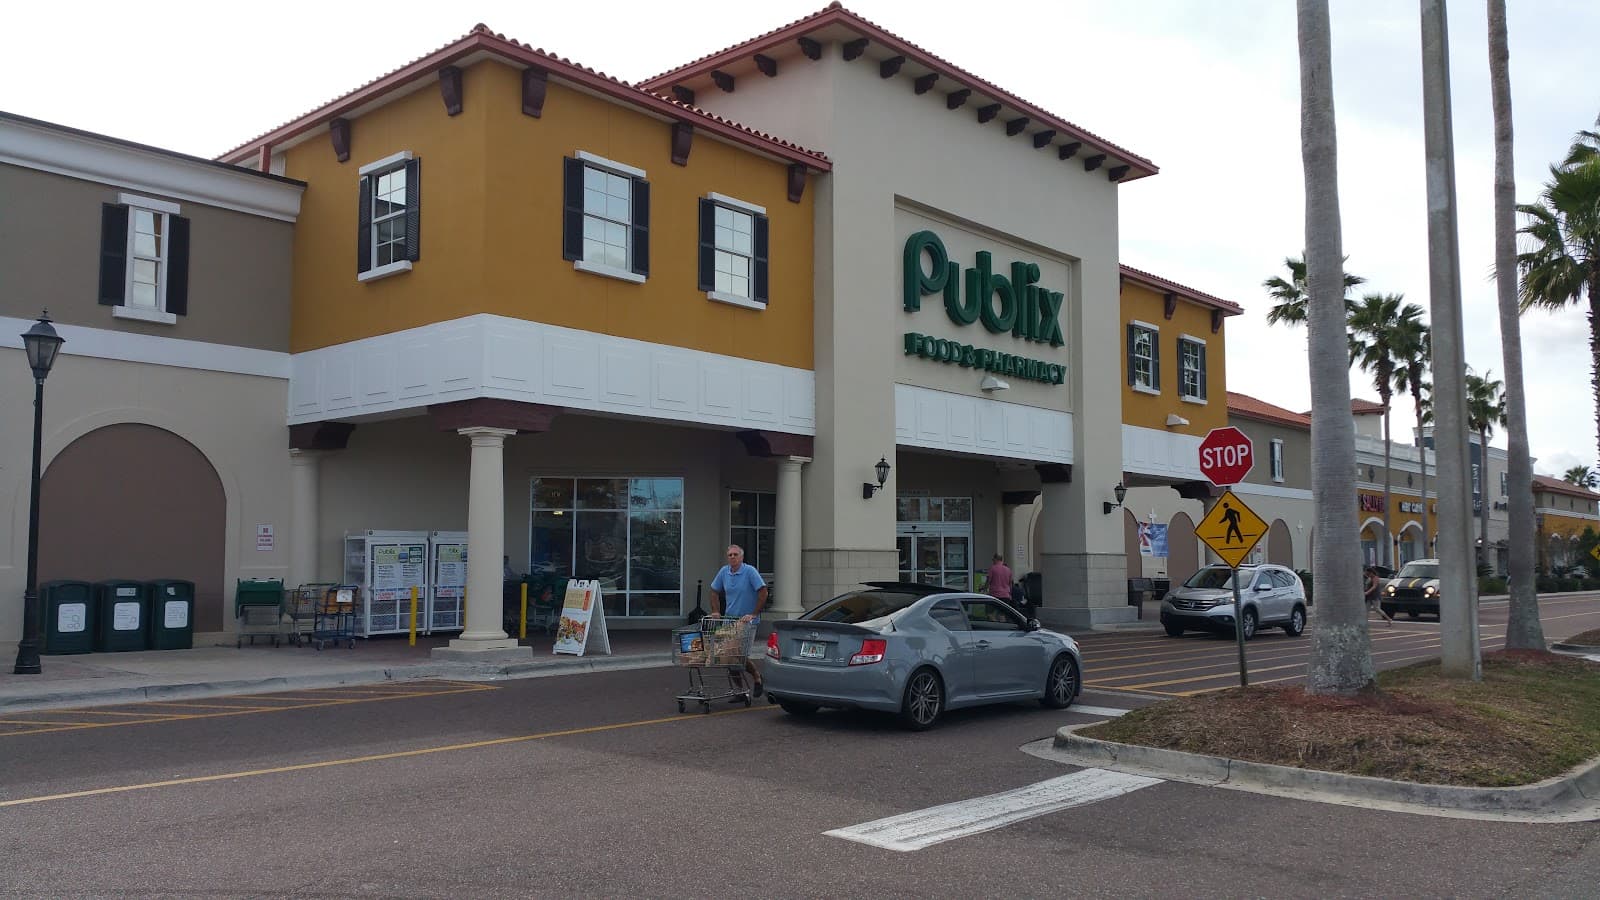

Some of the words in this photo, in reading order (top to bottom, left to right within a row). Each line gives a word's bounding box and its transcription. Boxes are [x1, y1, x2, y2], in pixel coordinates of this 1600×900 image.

[904, 230, 1064, 347] Publix
[904, 332, 964, 363] FOOD
[975, 348, 1067, 384] PHARMACY
[1202, 444, 1249, 469] STOP
